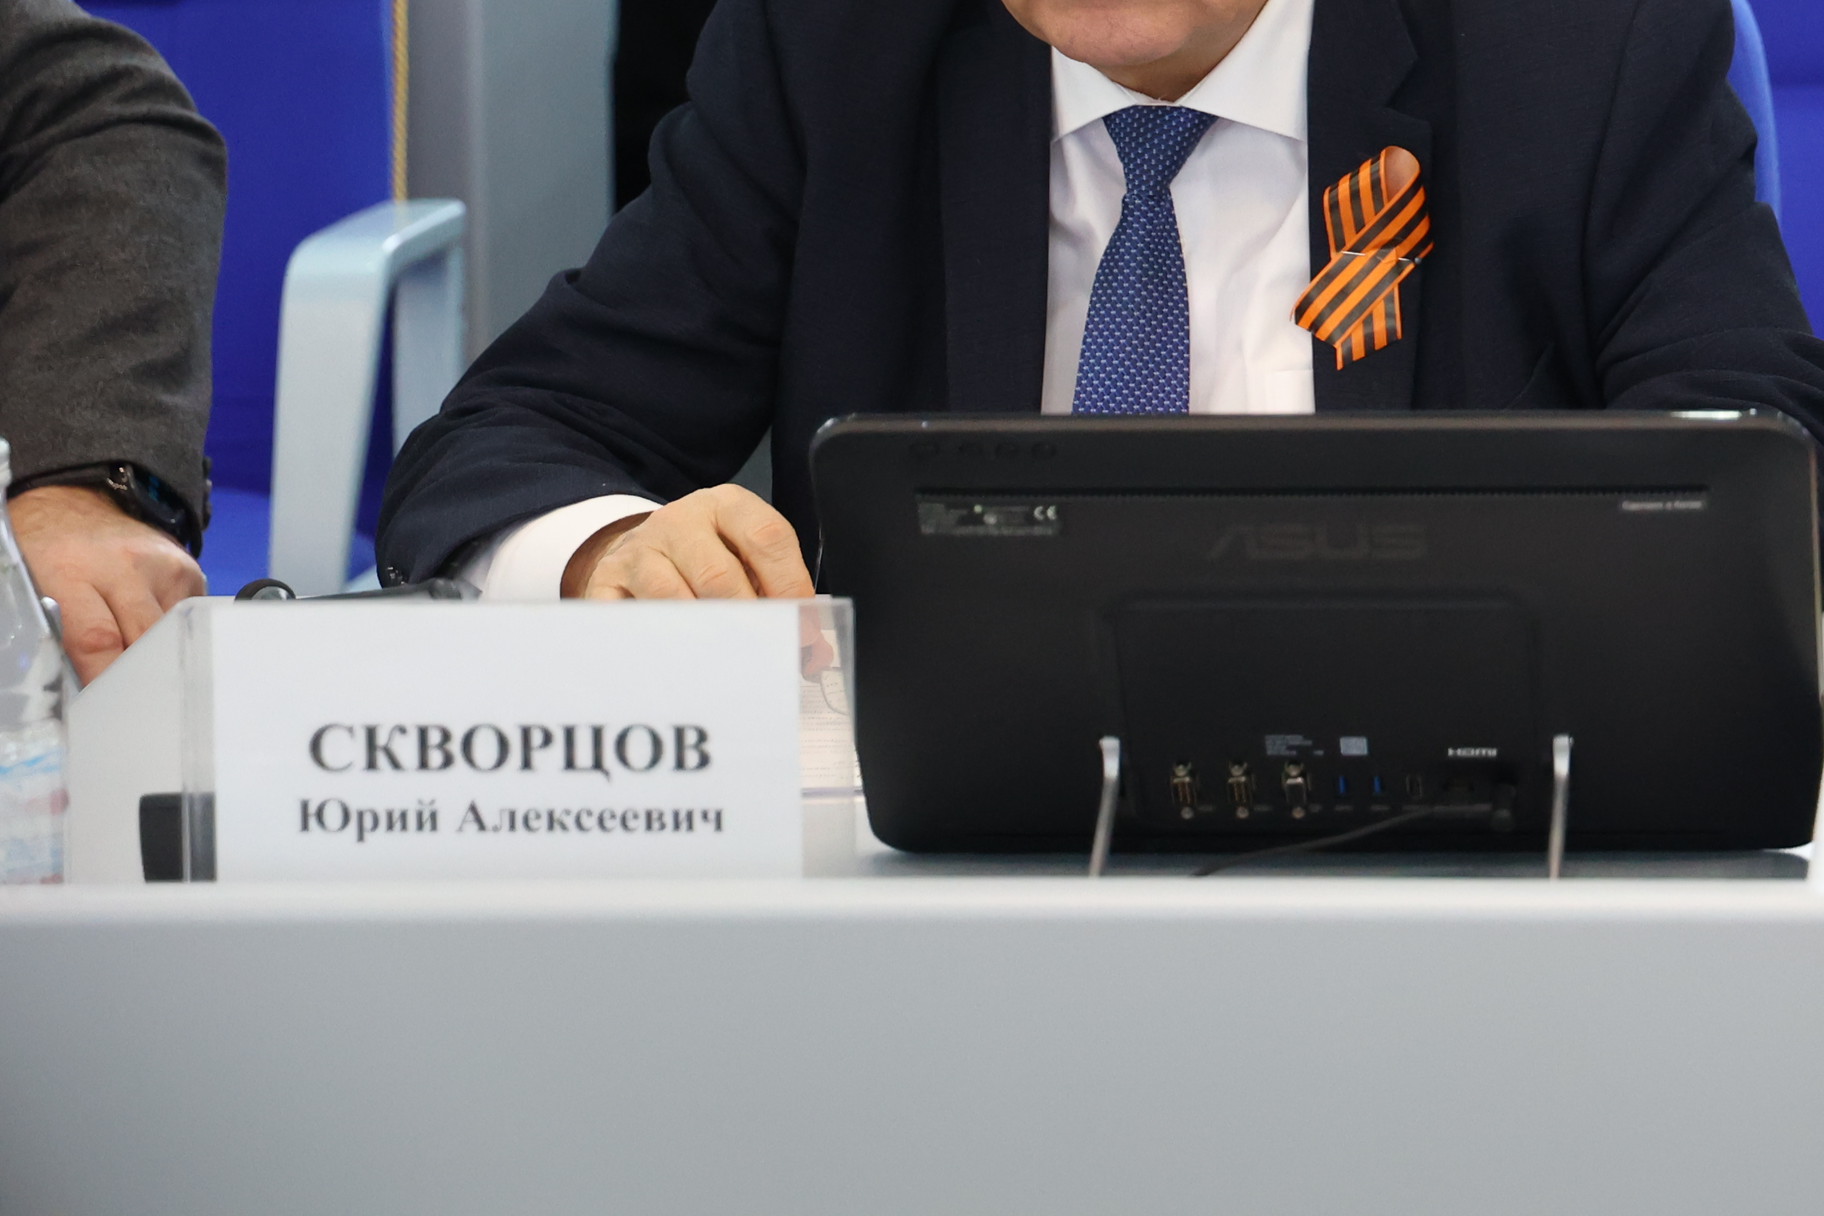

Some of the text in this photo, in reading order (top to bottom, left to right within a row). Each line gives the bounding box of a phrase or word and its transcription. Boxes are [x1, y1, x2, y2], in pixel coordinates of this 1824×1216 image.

[1208, 523, 1428, 561] ASUS
[308, 723, 711, 778] СКВОРЦОВ
[300, 798, 723, 842] Юрий Алексеевич
